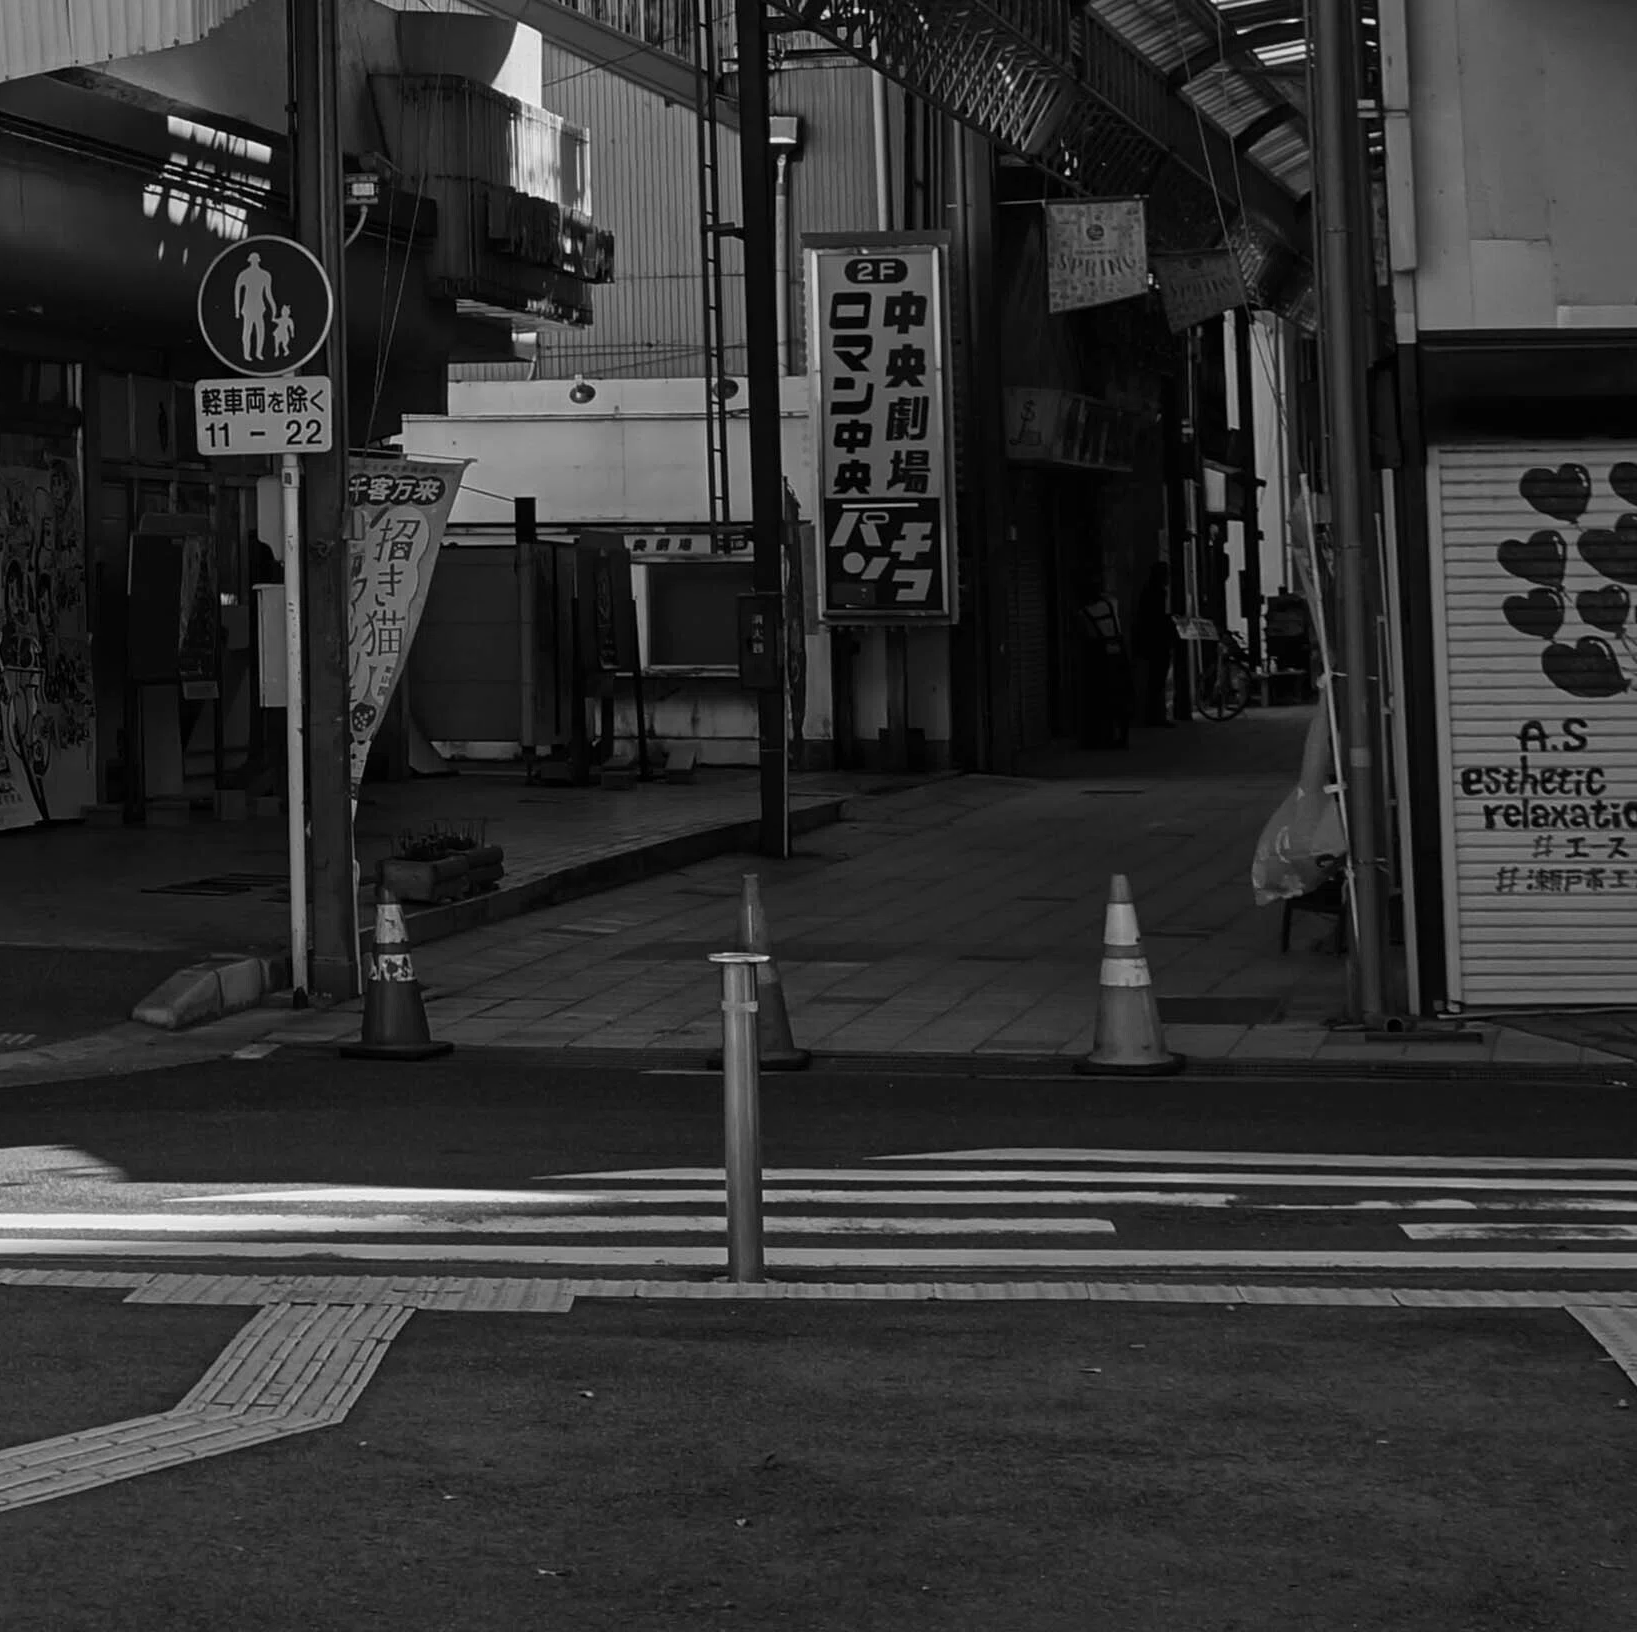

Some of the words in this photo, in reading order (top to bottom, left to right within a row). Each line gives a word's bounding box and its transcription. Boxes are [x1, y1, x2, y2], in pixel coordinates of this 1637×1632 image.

[856, 262, 897, 281] 2F
[1056, 252, 1138, 277] SPRING
[201, 384, 325, 417] 軽車両を除く
[829, 291, 874, 495] ロマン中央
[883, 290, 931, 494] 中央劇場
[205, 422, 230, 448] 11
[285, 419, 323, 446] 22
[349, 477, 442, 501] 千客万来
[362, 518, 421, 656] 招き猫
[1516, 718, 1589, 752] A.S
[1461, 755, 1607, 796] esthetic
[1495, 867, 1637, 892] #瀬戸市エ
